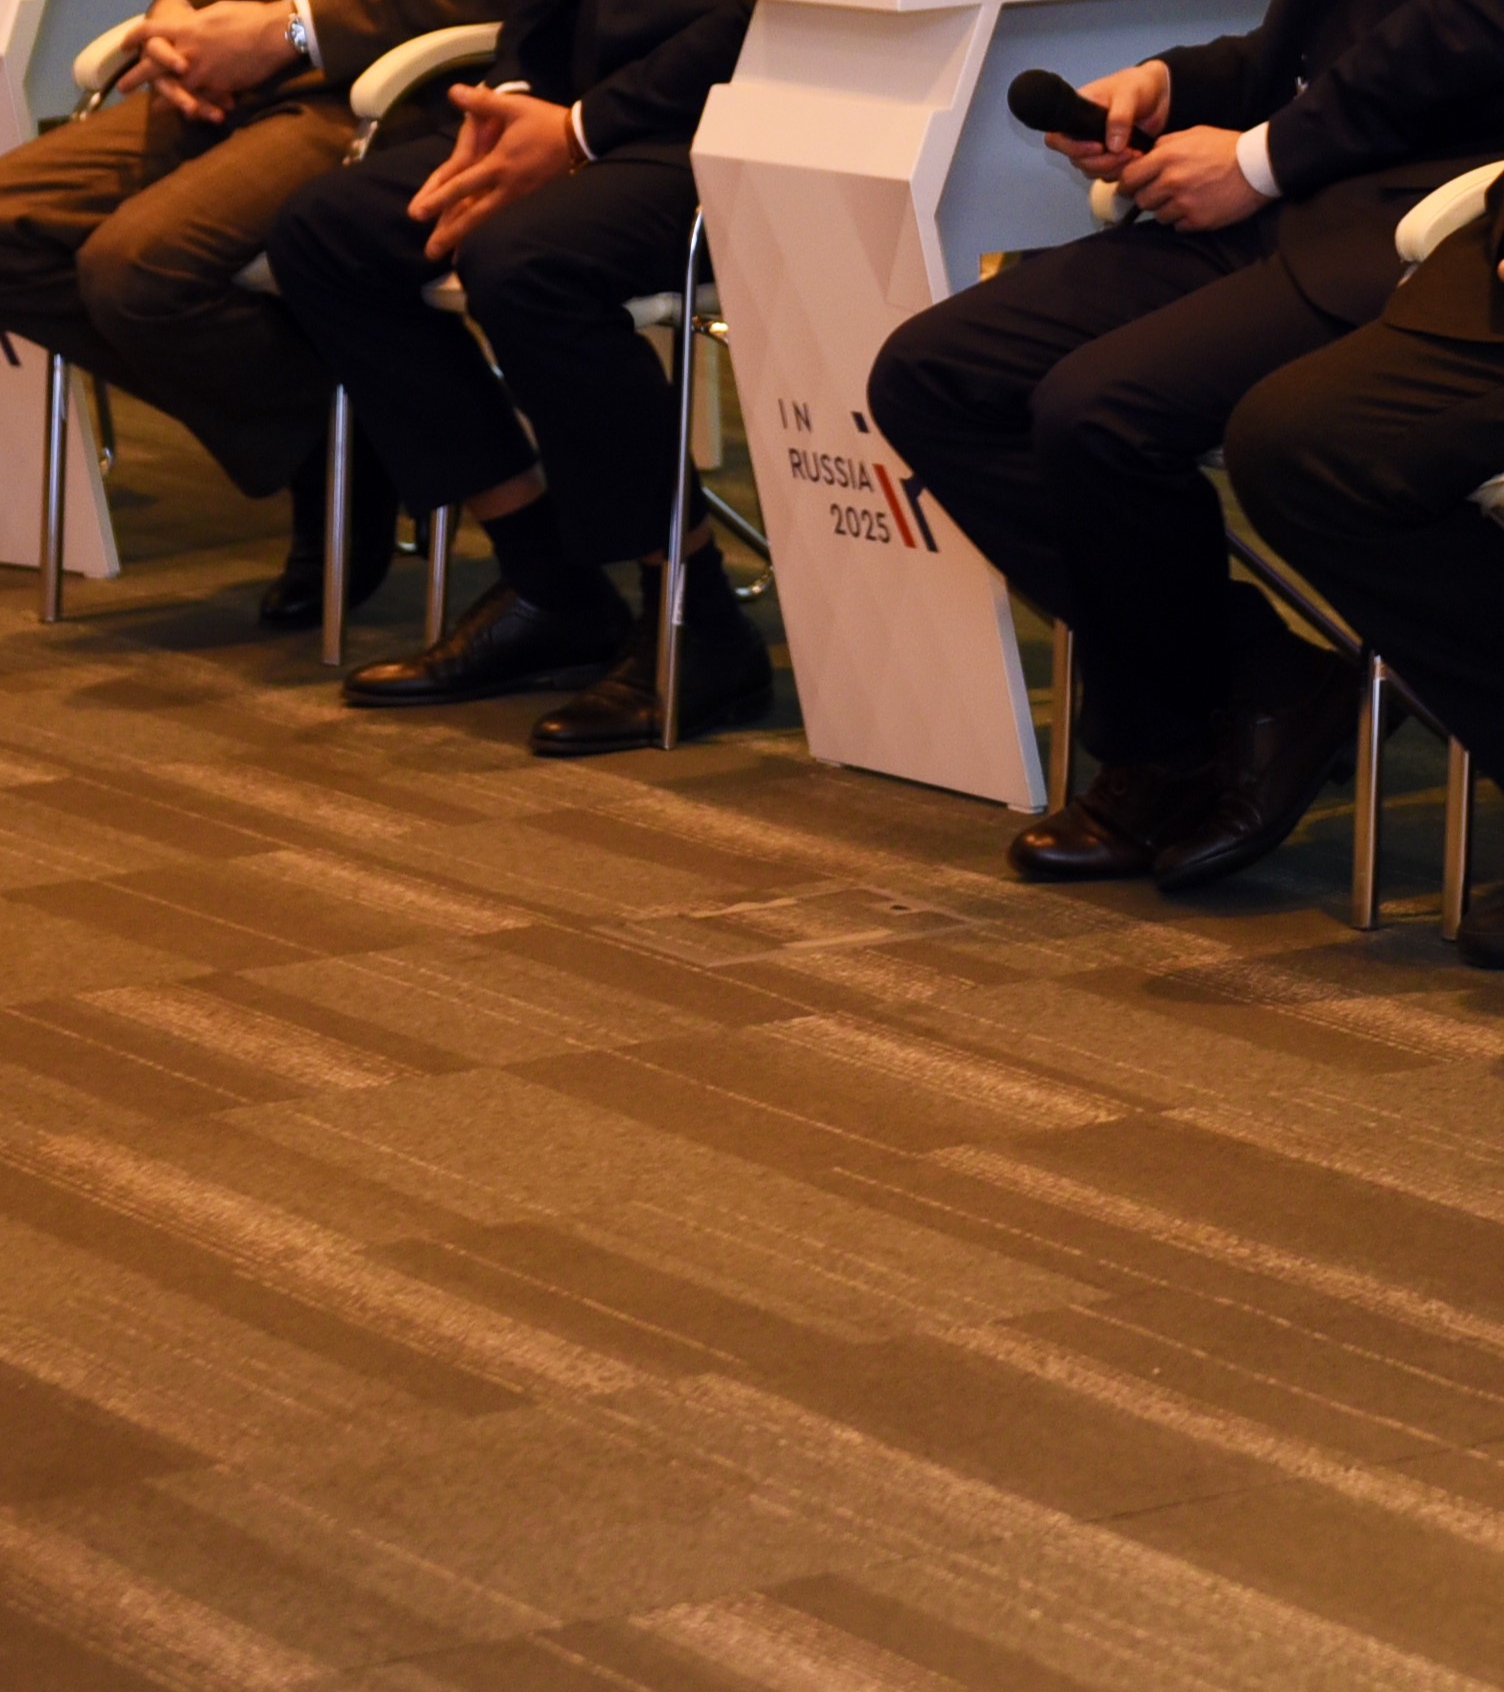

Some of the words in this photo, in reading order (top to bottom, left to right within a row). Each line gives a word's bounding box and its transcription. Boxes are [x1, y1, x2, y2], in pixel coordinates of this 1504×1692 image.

[777, 398, 812, 433] IN
[788, 447, 875, 493] RUSSIA
[830, 503, 892, 544] 2025
